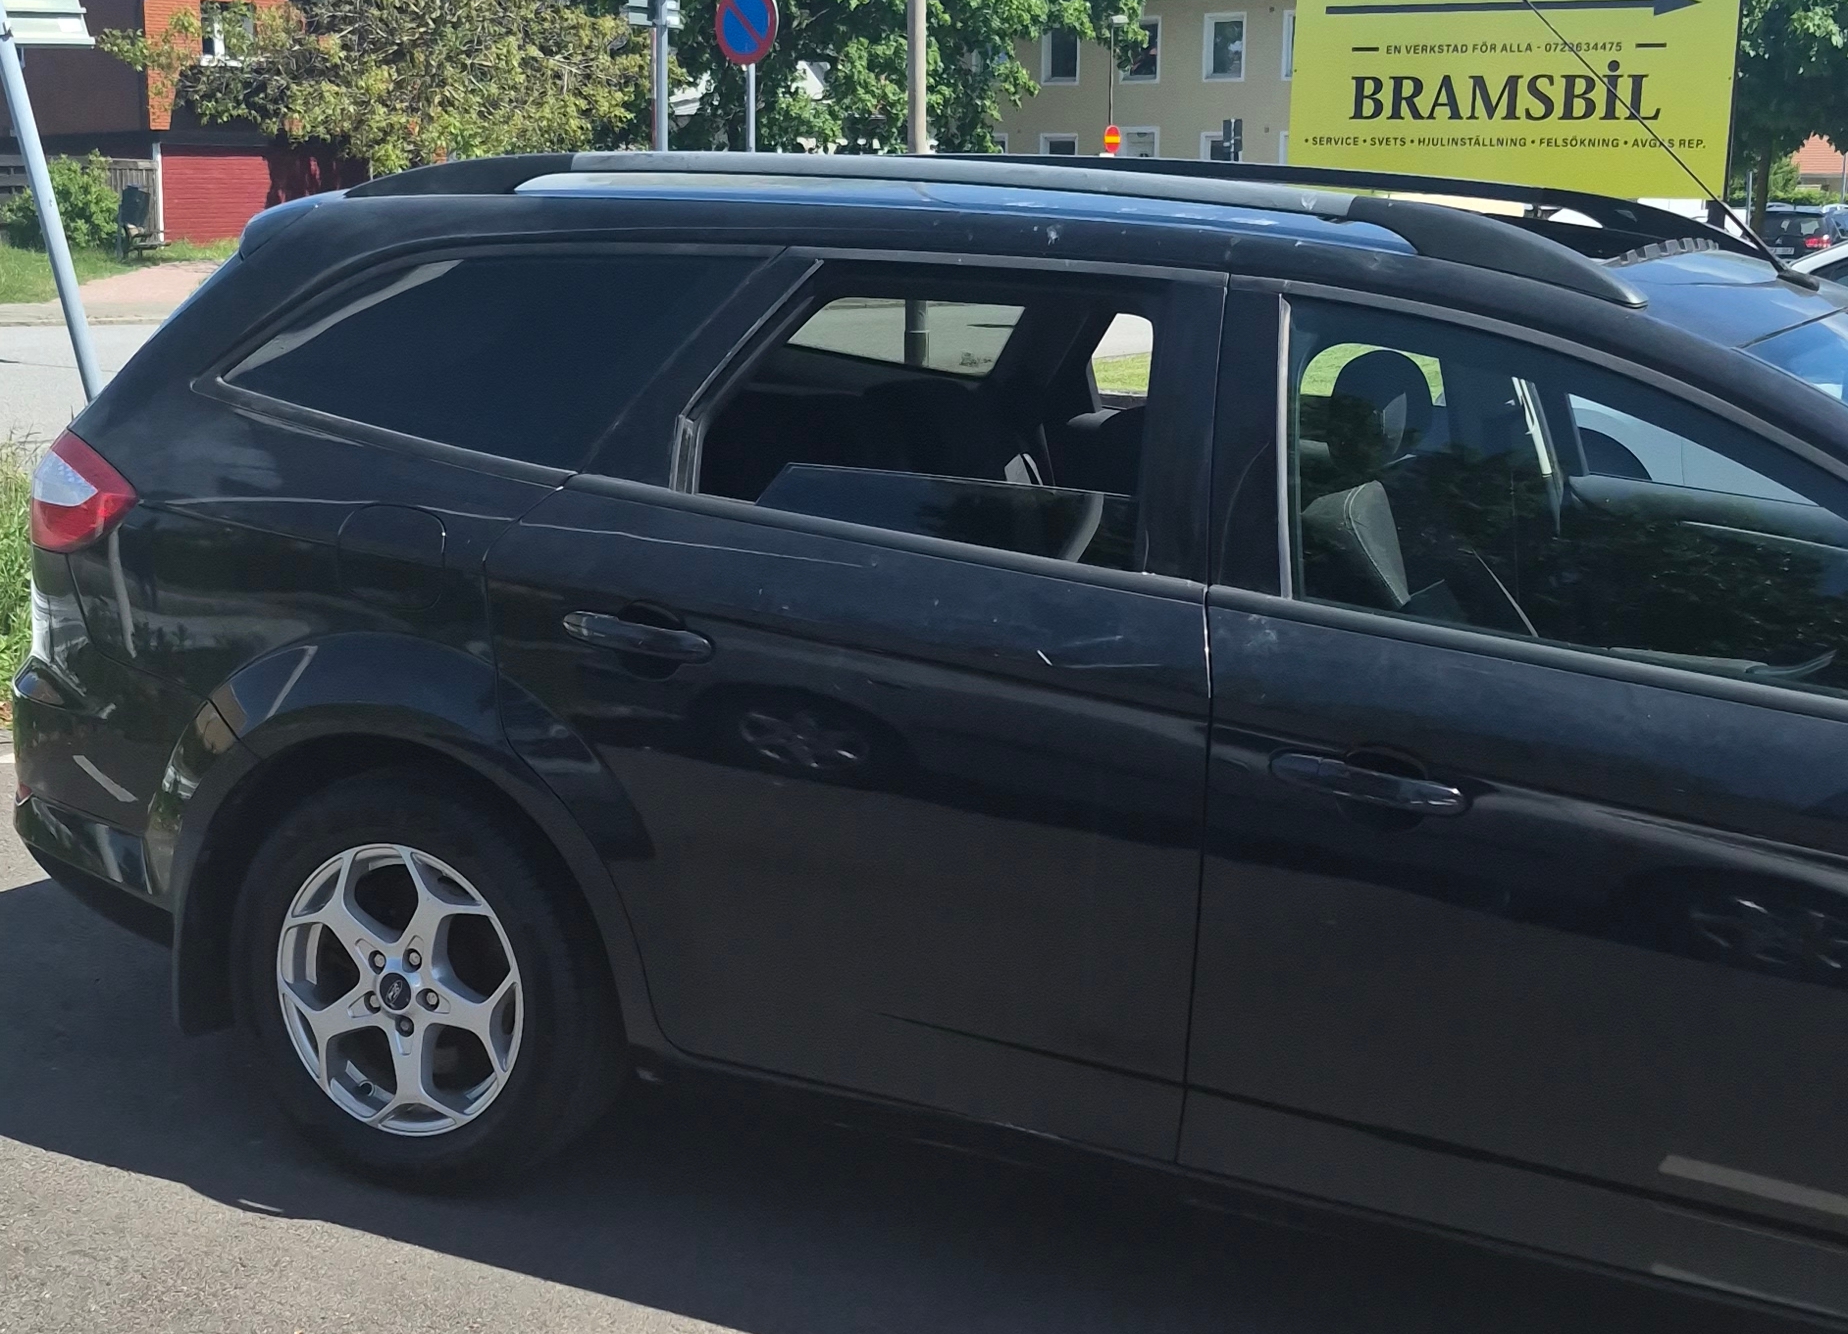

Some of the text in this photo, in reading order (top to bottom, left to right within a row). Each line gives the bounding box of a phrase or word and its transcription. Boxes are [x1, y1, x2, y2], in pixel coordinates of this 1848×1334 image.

[1386, 45, 1402, 55] EN
[1405, 43, 1468, 55] VERKSTAD
[1472, 41, 1497, 54] FÖR
[1500, 42, 1533, 53] ALLA
[1311, 136, 1359, 146] SERVICE
[1370, 136, 1406, 147] SVETS
[1417, 135, 1527, 148] HJULINSTÄLLNING
[1539, 136, 1620, 148] FELSÖKNING
[1679, 138, 1706, 149] REP.
